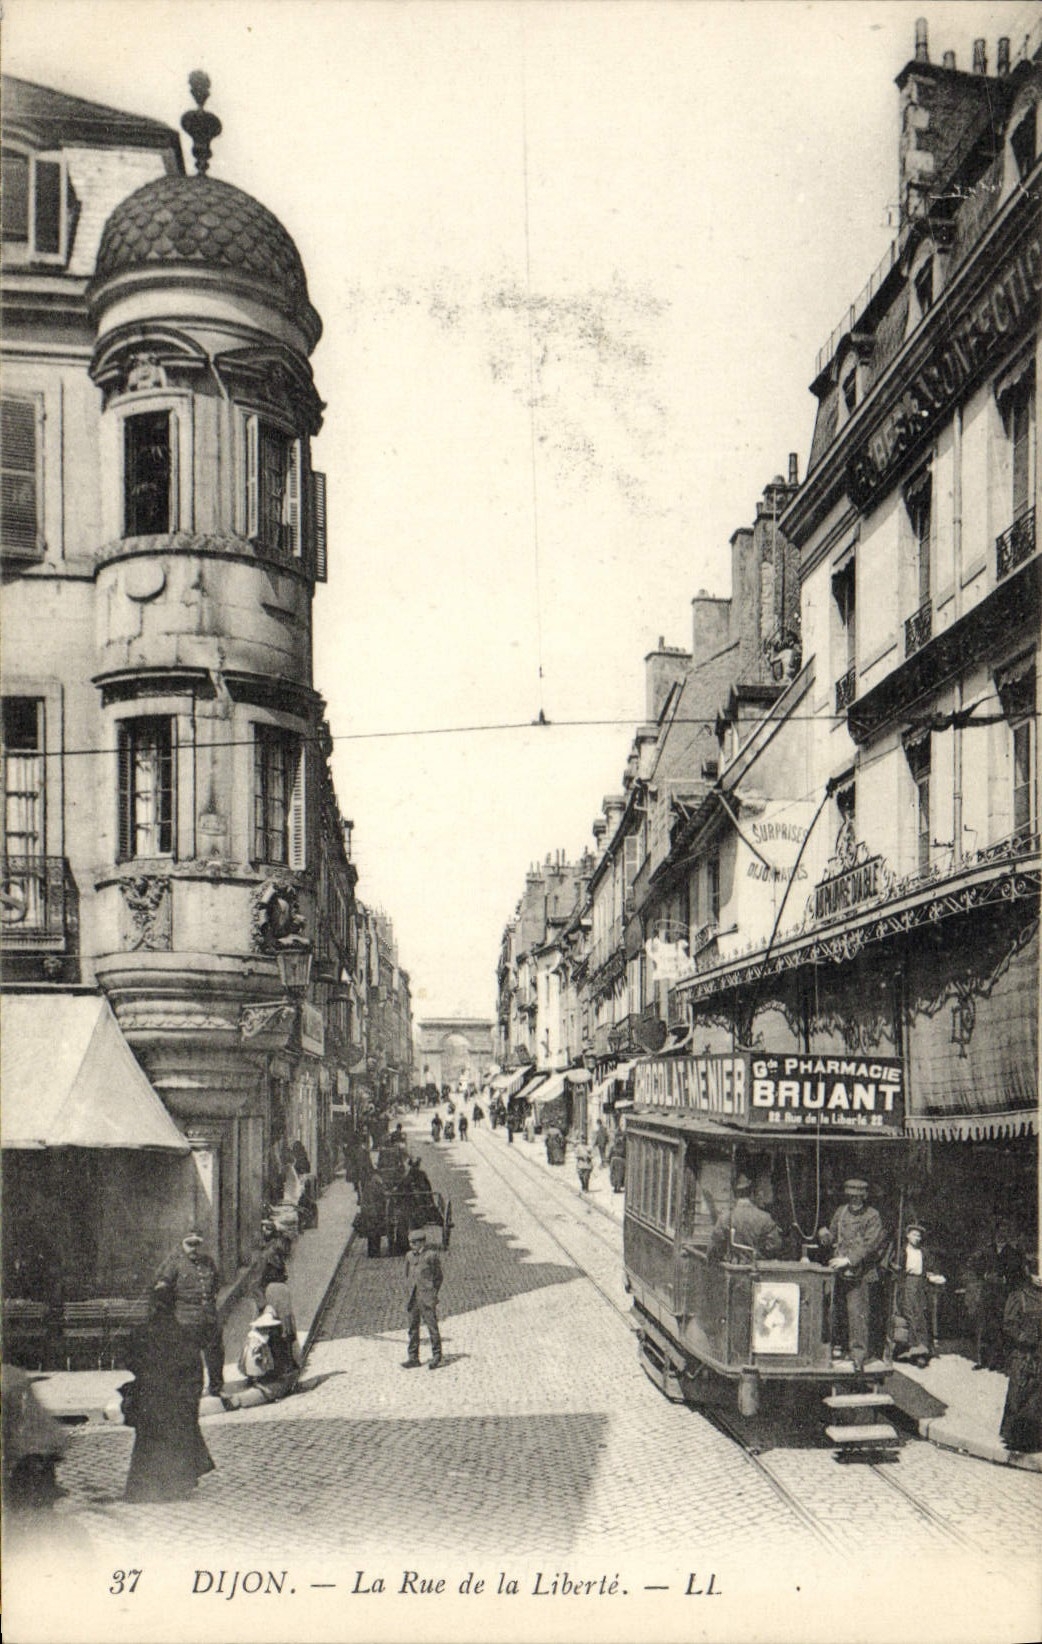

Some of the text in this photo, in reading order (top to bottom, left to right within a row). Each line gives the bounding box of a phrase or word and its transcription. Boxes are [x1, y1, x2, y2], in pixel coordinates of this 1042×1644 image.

[784, 1058, 902, 1083] PHARMACIE
[752, 1079, 902, 1111] BRUANT
[784, 1111, 802, 1124] Rue
[805, 1112, 817, 1125] de
[820, 1112, 830, 1125] la
